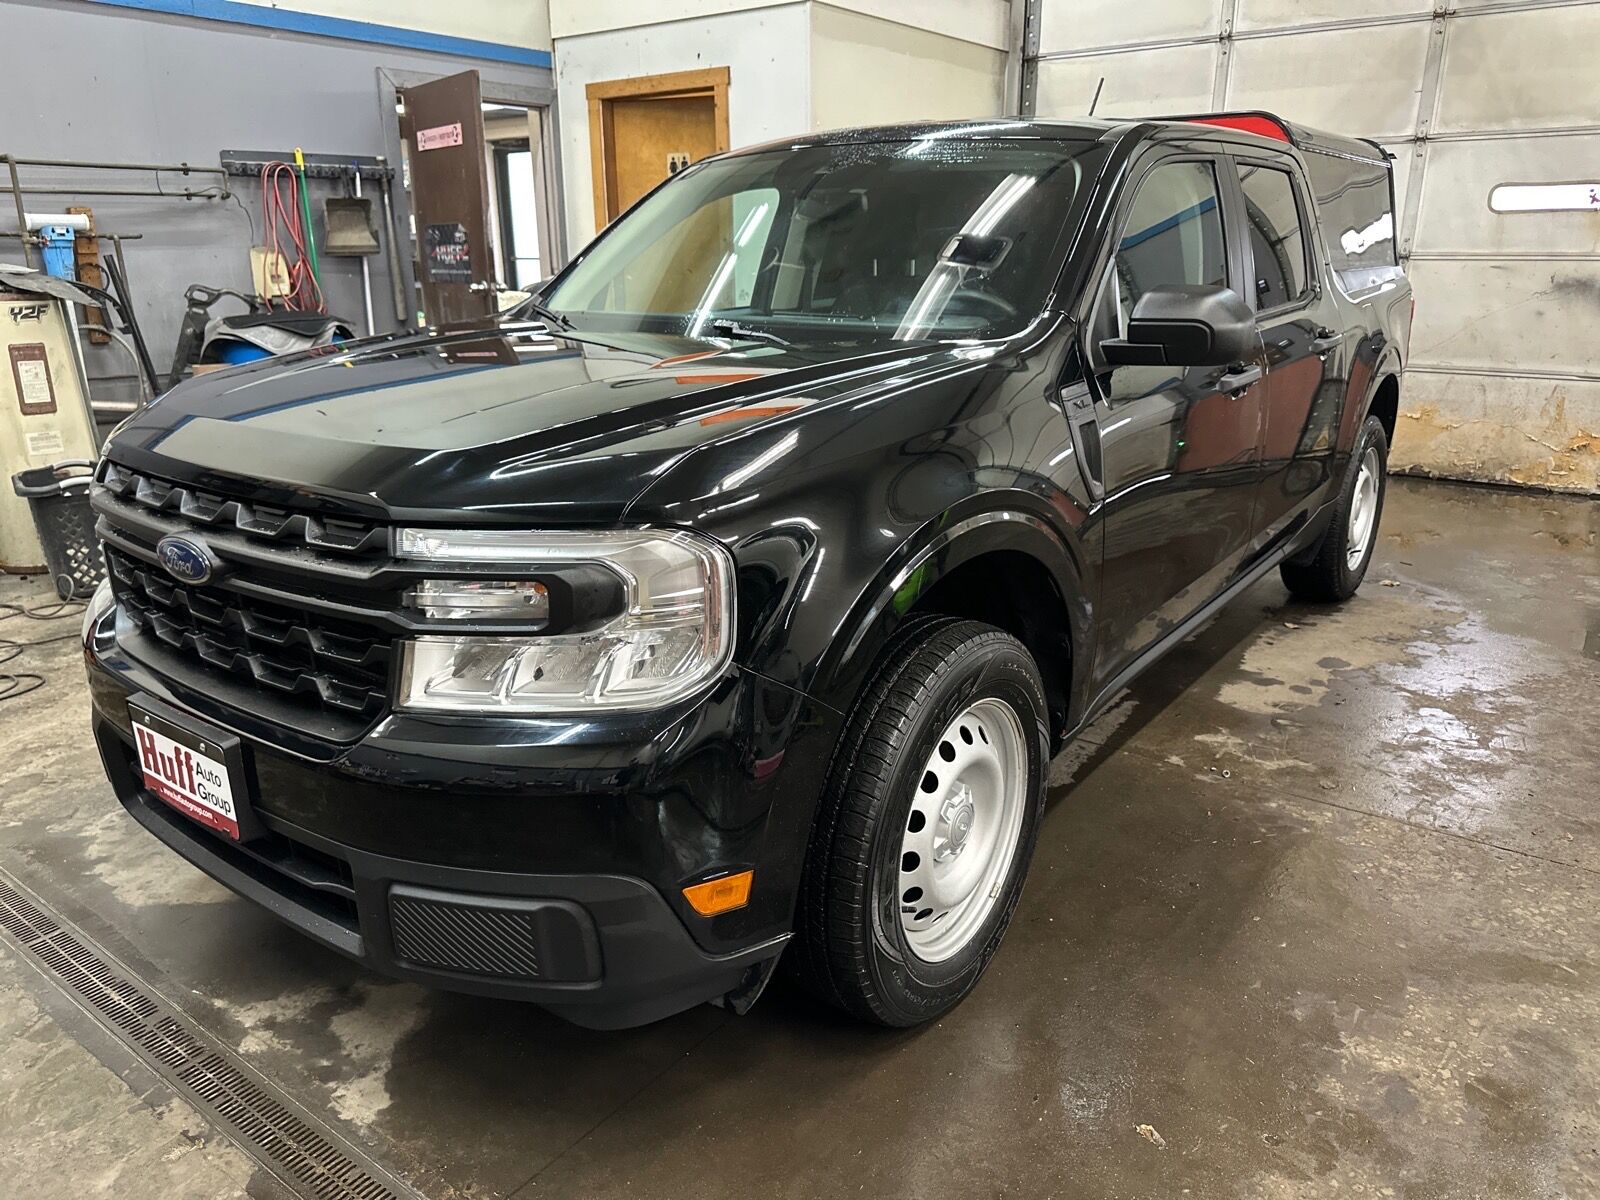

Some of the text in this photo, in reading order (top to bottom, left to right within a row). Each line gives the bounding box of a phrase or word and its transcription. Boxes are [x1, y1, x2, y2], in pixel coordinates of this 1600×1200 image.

[166, 546, 194, 575] Ford
[136, 727, 197, 796] Huff
[196, 761, 222, 787] Auto
[197, 783, 231, 815] Group
